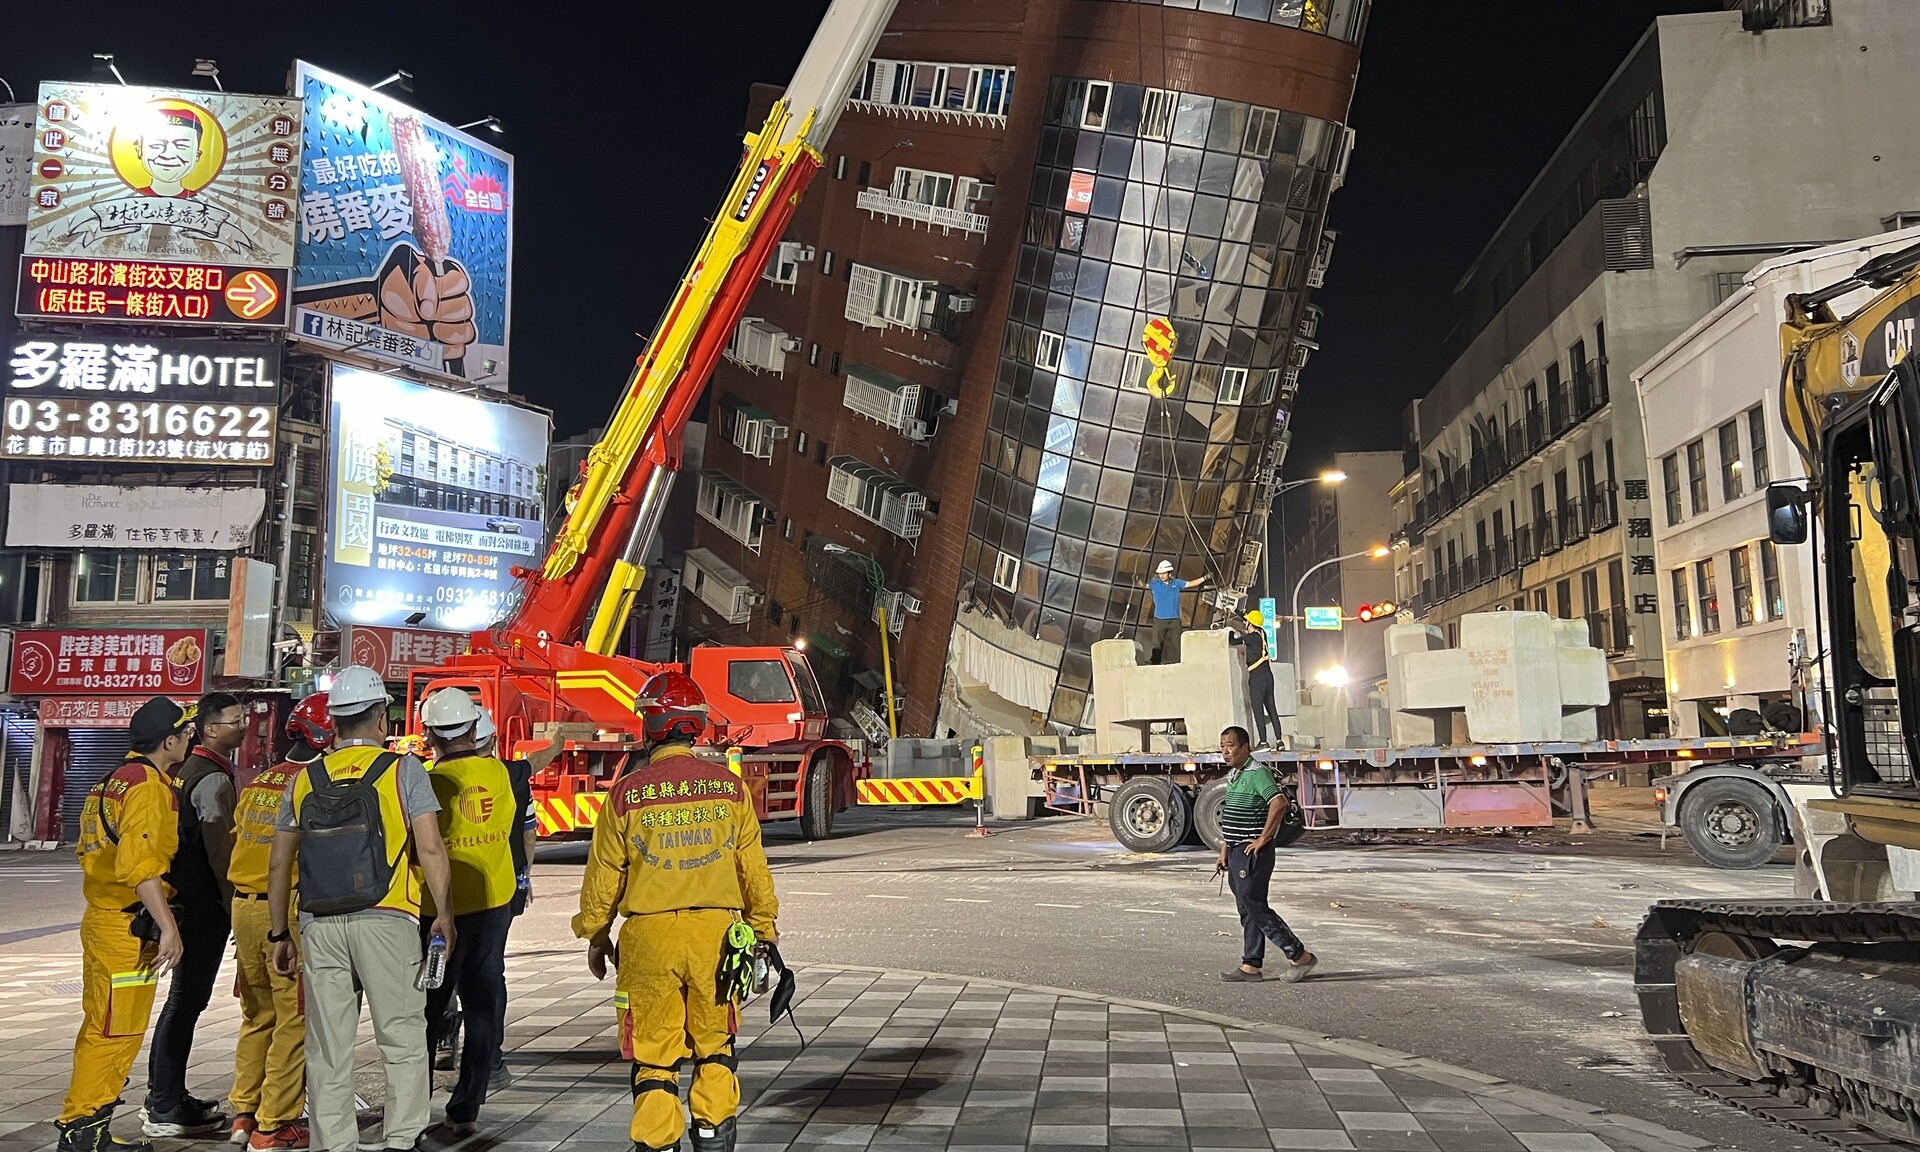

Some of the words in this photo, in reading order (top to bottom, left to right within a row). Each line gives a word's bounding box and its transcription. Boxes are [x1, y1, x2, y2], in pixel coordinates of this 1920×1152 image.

[40, 104, 66, 206] 僅此一家
[311, 152, 402, 185] 最好吃的
[267, 120, 291, 219] 別無分號
[300, 183, 414, 244] 燒番麥
[31, 263, 223, 291] 中山路北濱街交叉路口
[39, 289, 209, 318] (原住民一條街入口)
[1885, 318, 1915, 368] CAT
[10, 341, 159, 394] 多羅滿
[161, 354, 275, 389] HOTEL
[7, 399, 270, 437] 03-8316622
[68, 524, 117, 541] 多羅滿
[58, 635, 165, 657] 胖老爹美式炸雞
[58, 658, 163, 672] 石來運轉店
[84, 674, 162, 688] 03-8327130
[625, 779, 738, 804] 花蓮縣義消總隊
[641, 804, 730, 828] 特種搜救隊
[658, 828, 712, 849] TAIWAN
[663, 859, 673, 870] &
[679, 848, 722, 870] RESCUE
